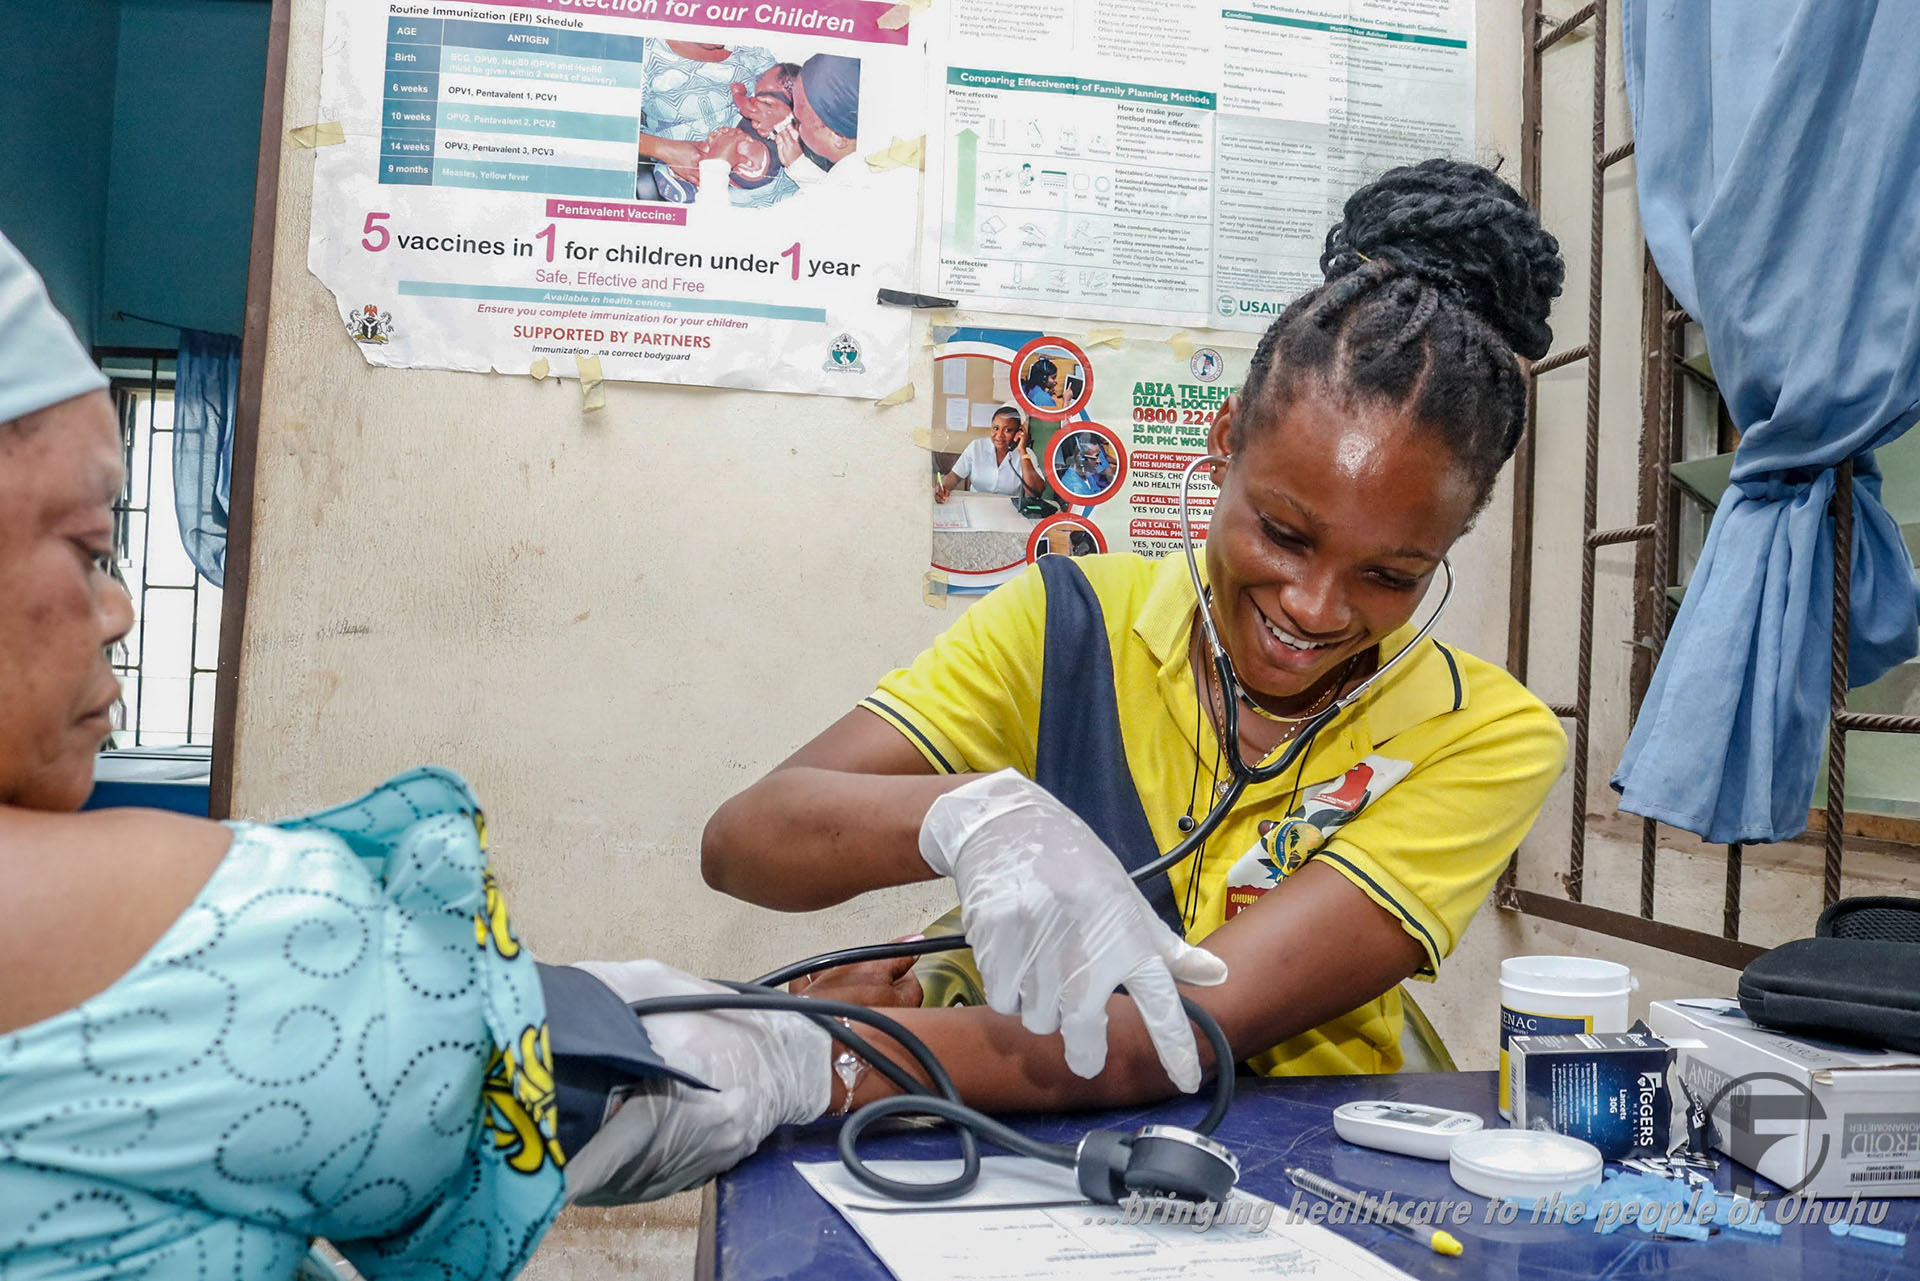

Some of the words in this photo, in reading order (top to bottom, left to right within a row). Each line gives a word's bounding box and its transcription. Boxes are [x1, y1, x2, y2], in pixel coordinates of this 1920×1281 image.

[389, 4, 430, 15] Routine
[433, 6, 506, 21] Immunization
[509, 12, 533, 25] (EPI)
[536, 14, 584, 29] Schedule
[666, 0, 699, 18] for
[706, 4, 748, 22] our
[754, 3, 856, 33] Children
[396, 27, 417, 36] AGE
[507, 34, 549, 45] ANTIGEN
[394, 53, 417, 62] Birth
[393, 84, 399, 92] 6
[400, 84, 428, 93] weeks
[448, 86, 474, 98] OPV1,
[476, 89, 524, 101] Pentavalent
[526, 92, 534, 102] 1,
[535, 93, 558, 102] PCV1
[960, 72, 1016, 88] Comparing
[1018, 76, 1079, 92] Effectiveness
[1082, 81, 1093, 92] of
[1094, 83, 1126, 97] Family
[1128, 87, 1168, 102] Planning
[1170, 91, 1211, 105] Methods
[1117, 104, 1134, 112] How
[391, 112, 402, 121] 10
[403, 112, 431, 122] weeks
[474, 115, 523, 127] Pentavalent
[533, 119, 556, 128] PCV2
[1117, 115, 1145, 123] method
[1168, 120, 1200, 129] effective:
[390, 142, 401, 151] 14
[402, 143, 430, 152] weeks
[445, 141, 471, 152] OPV3,
[472, 143, 522, 155] Pentavalent
[531, 147, 554, 157] PCV3
[388, 165, 394, 173] 9
[395, 164, 429, 174] months
[480, 170, 507, 181] Yellow
[508, 172, 529, 182] fever
[557, 204, 625, 218] Pentavalent
[627, 208, 676, 222] Vaccine:
[361, 212, 391, 252] 5
[398, 234, 505, 256] vaccines
[513, 238, 533, 257] in
[535, 223, 557, 263] 1
[565, 241, 601, 262] for
[605, 244, 702, 268] children
[710, 254, 780, 275] under
[781, 242, 801, 281] 1
[808, 258, 860, 278] year
[957, 260, 988, 268] effective
[535, 269, 572, 287] Safe,
[577, 271, 637, 288] Effective
[641, 276, 668, 290] and
[672, 278, 705, 293] Free
[543, 292, 588, 303] Available
[590, 293, 601, 304] in
[602, 294, 634, 306] health
[635, 298, 672, 309] centres
[477, 304, 517, 316] Ensure
[518, 308, 537, 319] you
[539, 307, 588, 320] complete
[590, 309, 661, 324] immunization
[663, 314, 678, 324] for
[680, 317, 705, 328] your
[706, 317, 749, 329] children
[513, 325, 605, 342] SUPPORTED
[610, 331, 628, 344] BY
[633, 332, 711, 349] PARTNERS
[531, 345, 589, 356] Immunization
[611, 350, 643, 359] correct
[644, 350, 691, 362] bodyguard
[1133, 381, 1175, 397] ABIA
[1133, 407, 1178, 424] 0800
[1133, 424, 1145, 433] IS
[1147, 425, 1174, 435] NOW
[1175, 426, 1201, 436] FREE
[1133, 434, 1154, 445] FOR
[1157, 436, 1178, 446] PHC
[1132, 471, 1166, 480] NURSES,
[1151, 482, 1181, 490] HEALTH
[1149, 506, 1166, 514] YOU
[1133, 540, 1149, 549] YES,
[1688, 1063, 1746, 1108] ANEROID
[1609, 1096, 1618, 1114] 30G
[1619, 1089, 1628, 1120] Lancets
